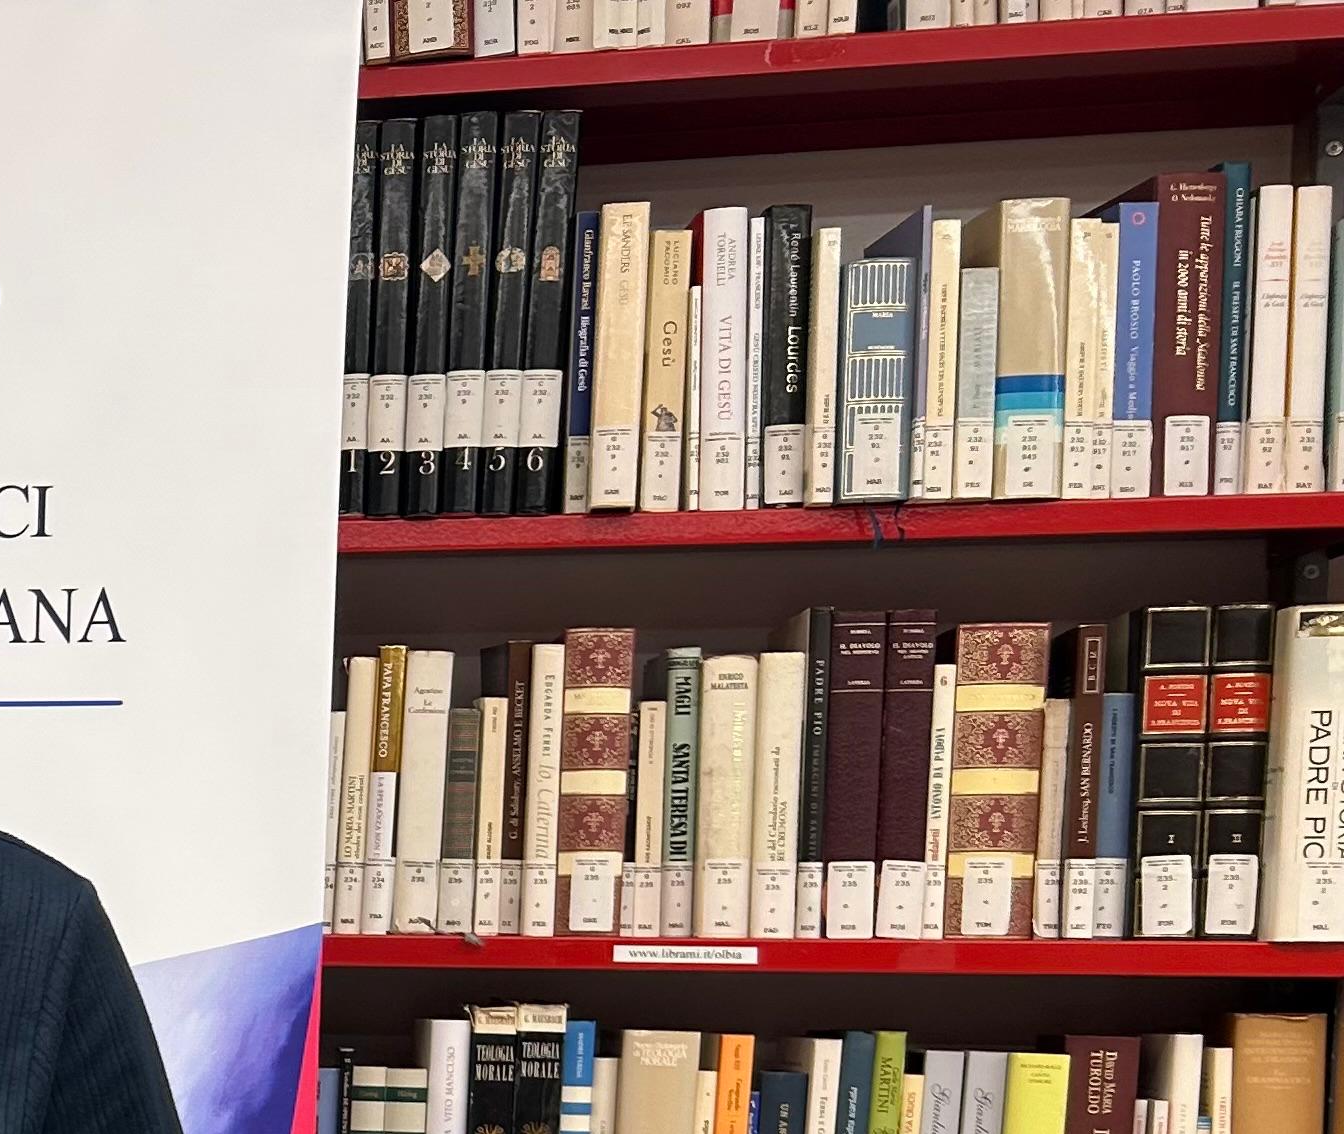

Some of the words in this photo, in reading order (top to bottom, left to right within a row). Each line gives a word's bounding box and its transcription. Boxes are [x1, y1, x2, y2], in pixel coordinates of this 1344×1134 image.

[716, 232, 727, 287] TORNIELLI
[727, 238, 736, 281] ANDREA
[1131, 260, 1141, 297] PAOLO
[719, 315, 732, 353] VITA
[1129, 298, 1140, 339] BROSIO
[661, 321, 678, 367] Gesù
[785, 325, 802, 394] Lourdes
[717, 360, 731, 376] DI
[717, 380, 731, 421] GESÙ
[379, 451, 396, 475] 2
[419, 451, 436, 475] 3
[489, 447, 505, 472] 5
[527, 447, 544, 472] 6
[384, 663, 393, 690] PAPA
[814, 660, 826, 705] PADRE
[675, 676, 691, 717] MAGLI
[378, 692, 392, 758] FRANCESCO
[812, 712, 822, 736] PIO
[671, 743, 691, 786] SANTA
[1306, 709, 1332, 806] PADRE
[669, 787, 689, 838] TERESA
[669, 840, 687, 856] DI
[629, 948, 742, 961] www.librami.it/olbia
[476, 1044, 514, 1062] TEOLOGIA
[522, 1042, 560, 1059] TEOLOGIA
[474, 1064, 514, 1081] MORALE
[520, 1062, 560, 1078] MORALE
[877, 1056, 893, 1114] MARTINI
[1087, 1050, 1103, 1115] TUROLDO
